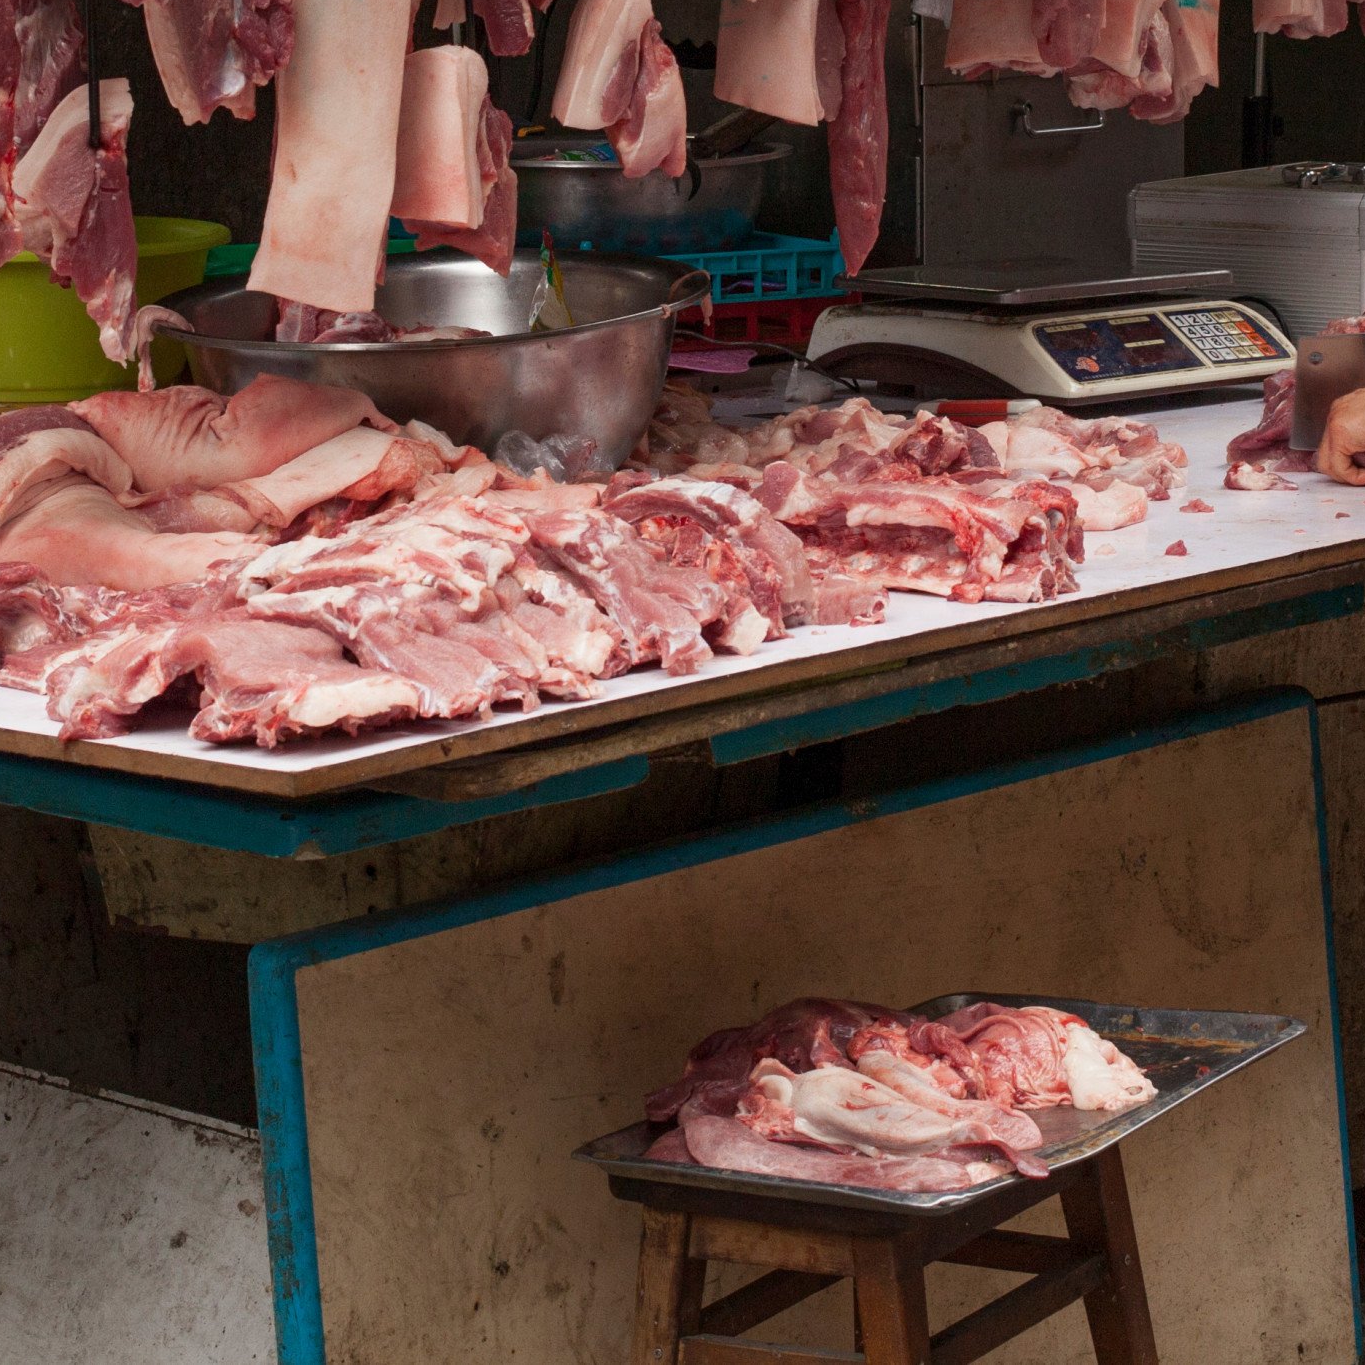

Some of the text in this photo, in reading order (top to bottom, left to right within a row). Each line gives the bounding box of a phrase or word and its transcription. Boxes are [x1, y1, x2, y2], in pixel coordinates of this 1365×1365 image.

[1175, 317, 1184, 326] 1
[1188, 315, 1199, 324] 2
[1201, 313, 1213, 323] 3
[1187, 325, 1223, 338] 4 5 6
[1196, 336, 1235, 349] 7 8 9
[1209, 350, 1219, 359] 0
